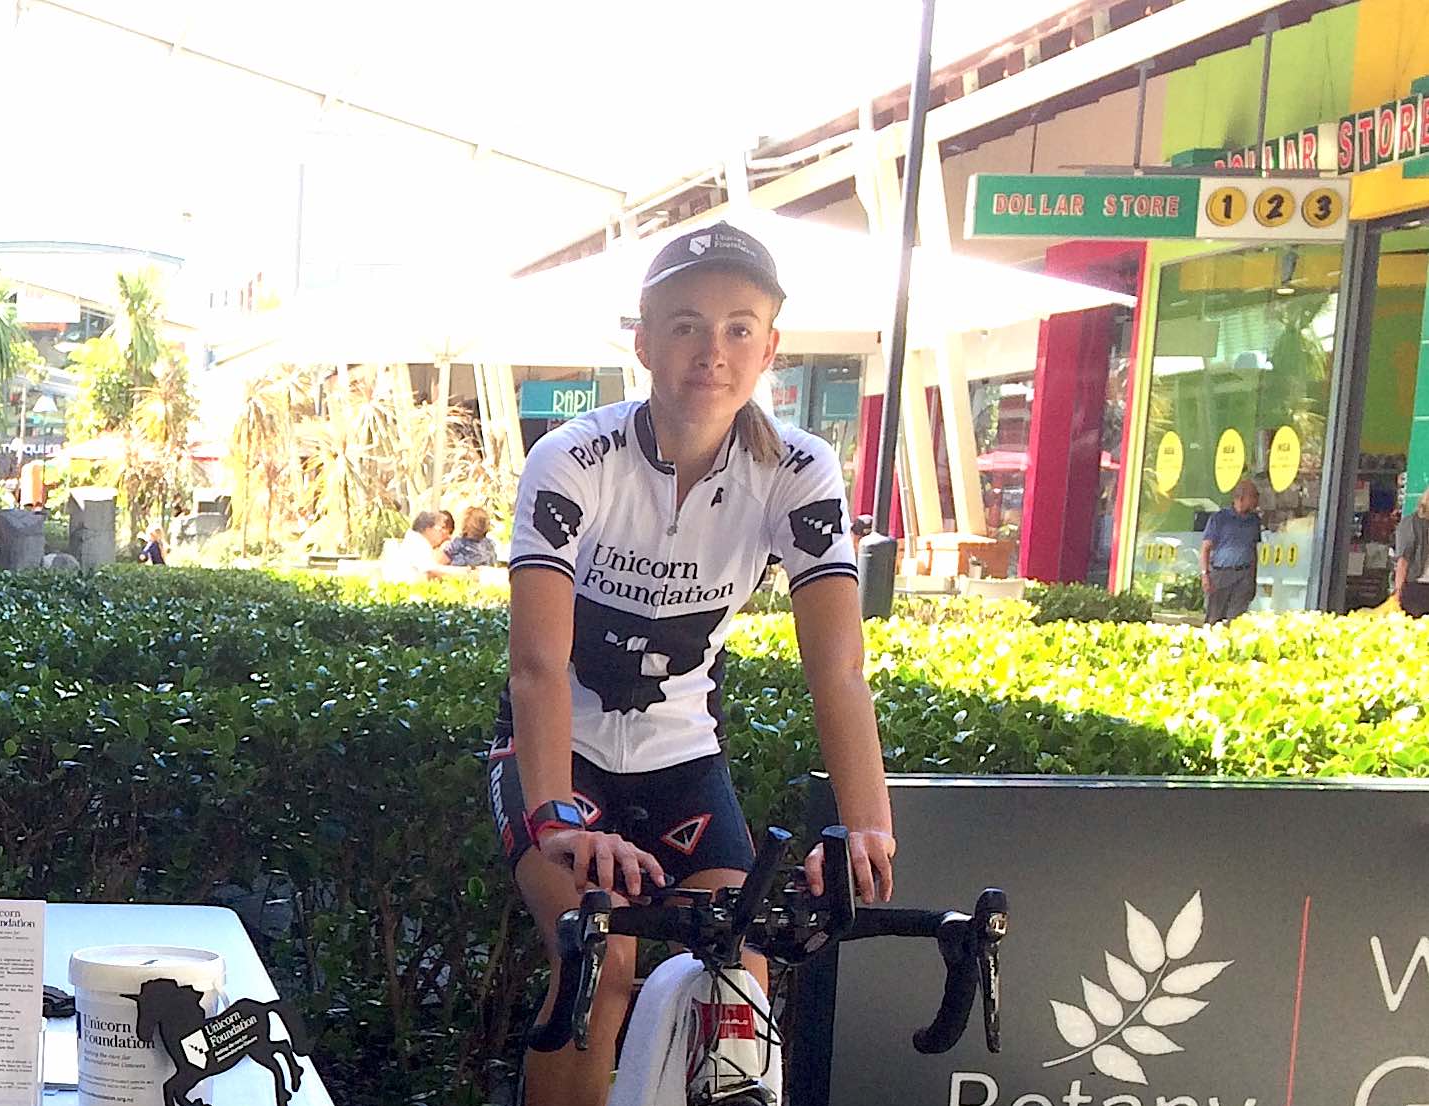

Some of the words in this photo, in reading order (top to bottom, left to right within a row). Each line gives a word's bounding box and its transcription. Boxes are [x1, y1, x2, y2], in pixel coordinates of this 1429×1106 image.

[1338, 96, 1429, 170] STORE
[992, 193, 1085, 216] DOLLAR
[1102, 194, 1180, 217] STORE
[1265, 194, 1285, 220] 2
[1314, 195, 1332, 221] 3
[592, 544, 699, 580] Unicorn
[582, 568, 734, 607] Foundation
[83, 1014, 131, 1033] Unicorn
[83, 1028, 155, 1049] Foundation
[204, 1011, 242, 1036] Unicorn
[209, 1015, 258, 1048] Foundation
